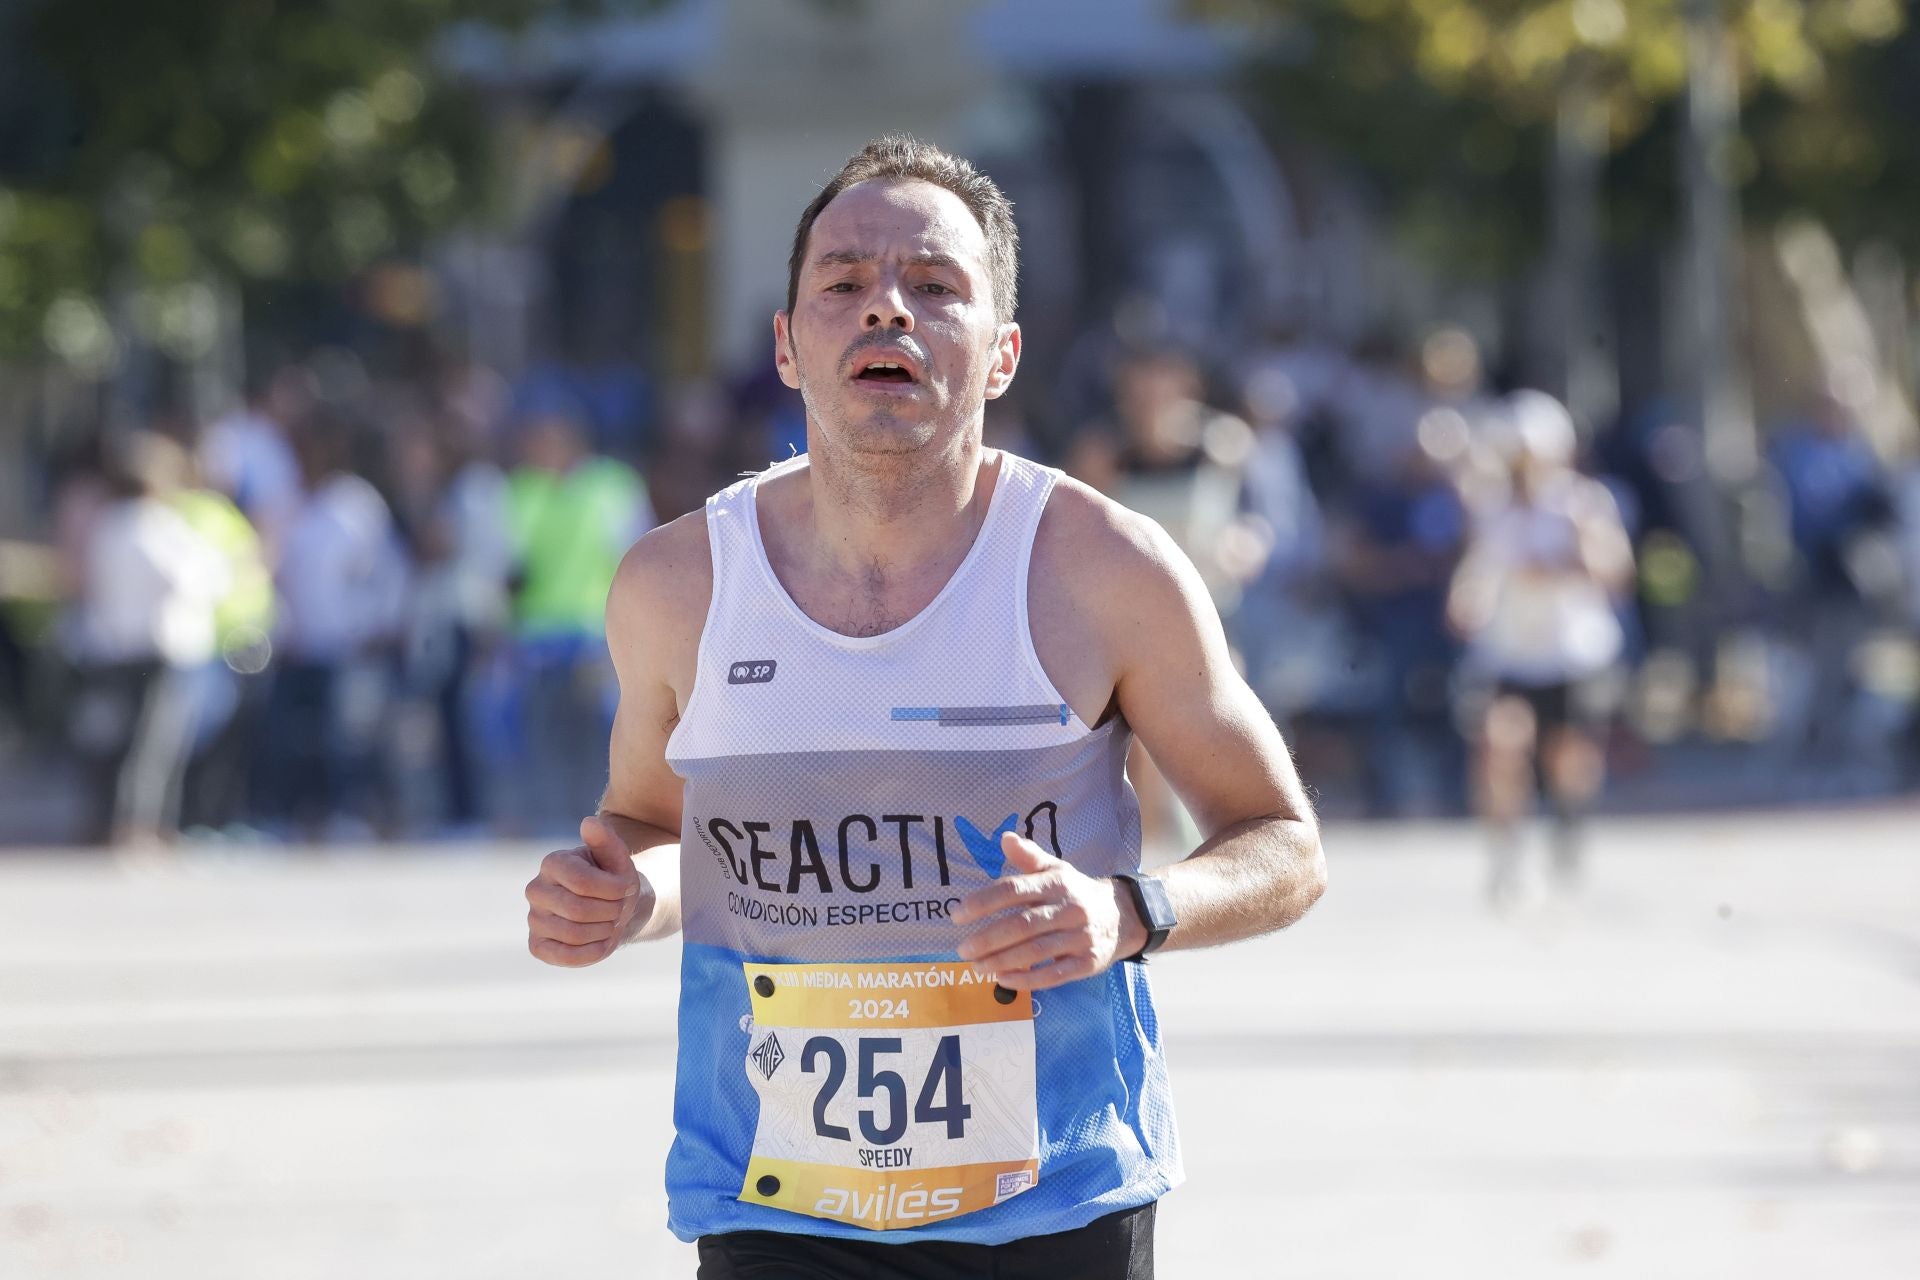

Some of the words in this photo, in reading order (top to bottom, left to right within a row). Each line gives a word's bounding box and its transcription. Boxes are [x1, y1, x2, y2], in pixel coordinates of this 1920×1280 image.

[751, 665, 770, 679] SP
[692, 816, 721, 859] DEPORTIVO
[717, 857, 731, 880] CLUB
[728, 891, 817, 926] CONDICIÓN
[802, 971, 853, 989] MEDIA
[857, 966, 955, 989] MARATÓN
[959, 969, 999, 985] AVIL
[848, 999, 910, 1019] 2024
[800, 1034, 972, 1146] 254
[859, 1147, 913, 1168] SPEEDY
[814, 1182, 964, 1222] avilés
